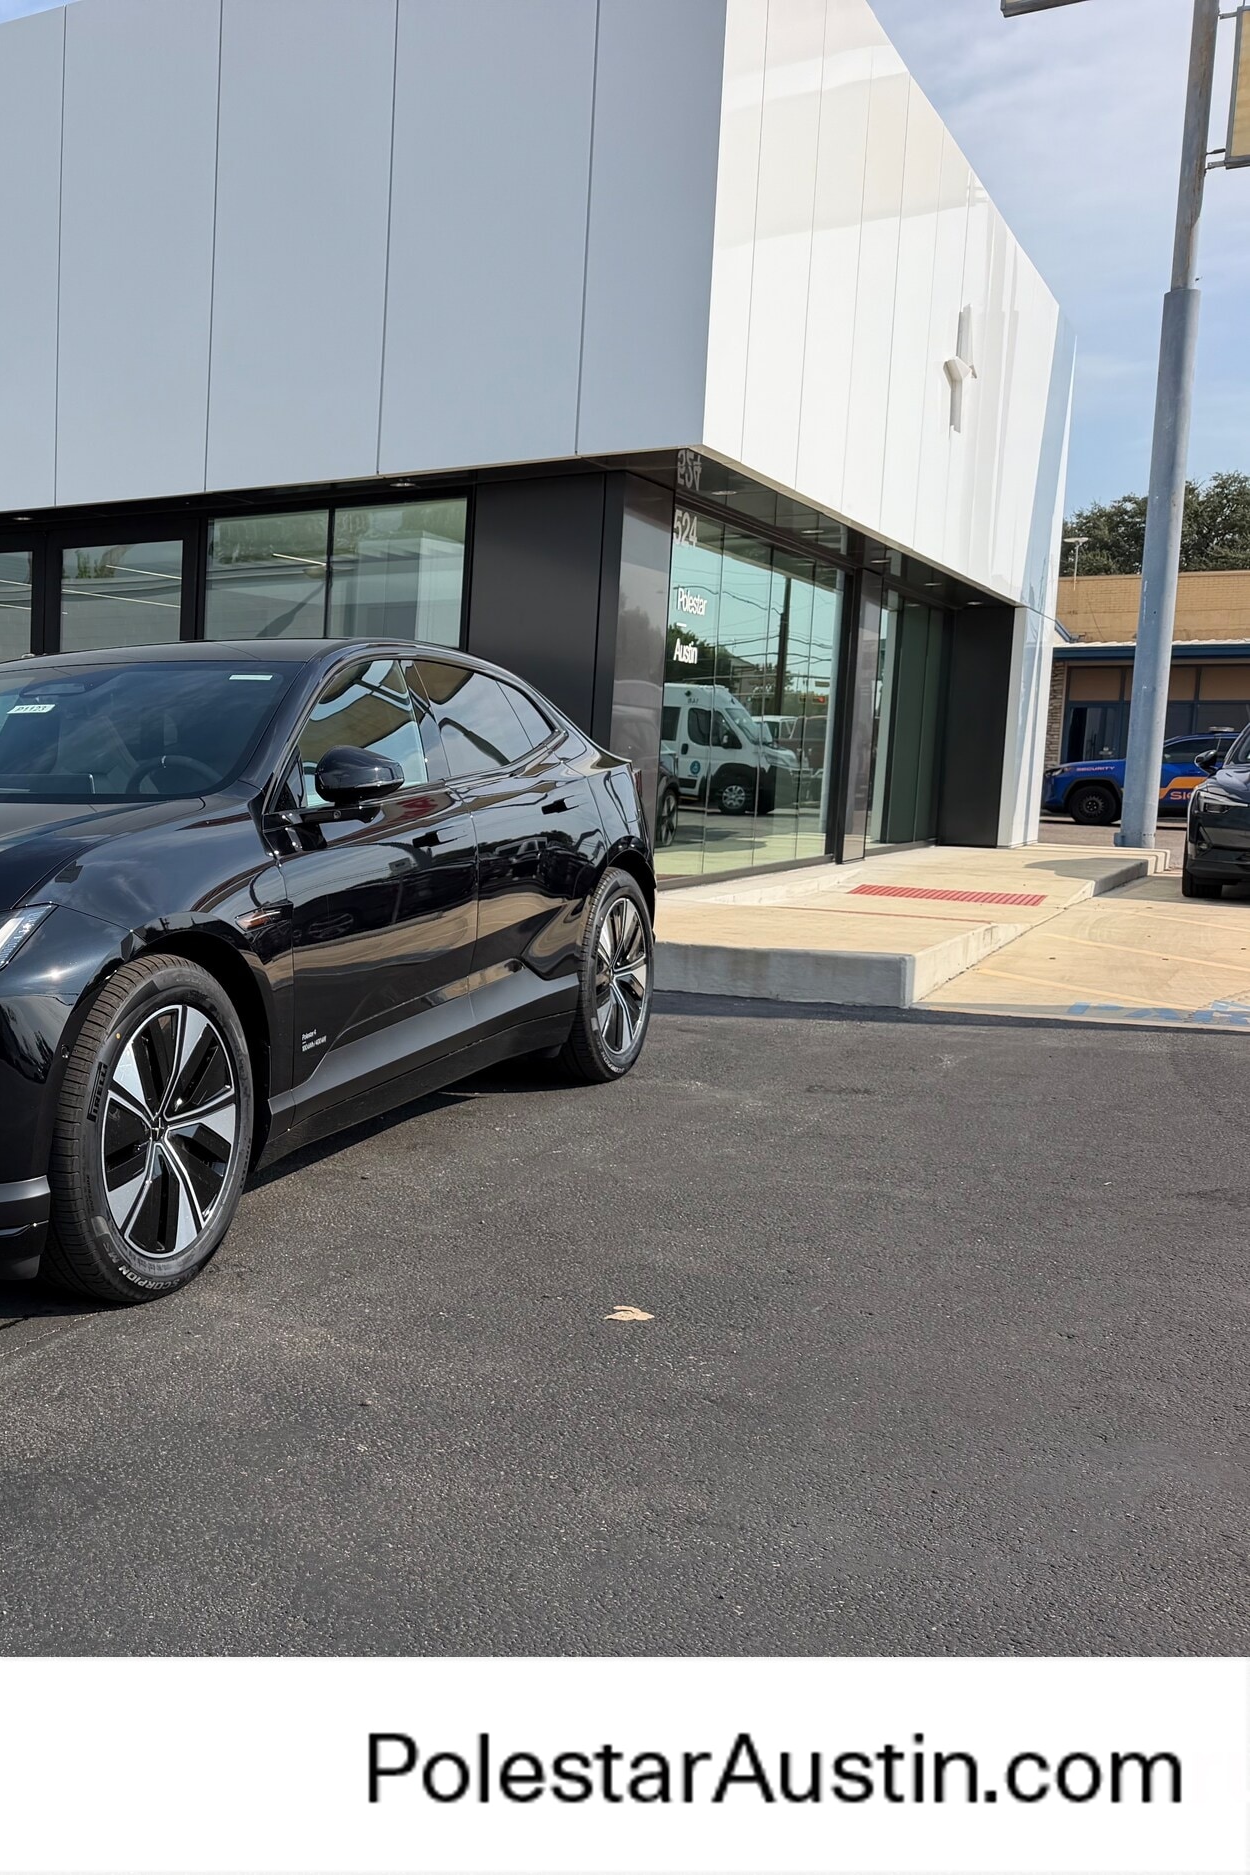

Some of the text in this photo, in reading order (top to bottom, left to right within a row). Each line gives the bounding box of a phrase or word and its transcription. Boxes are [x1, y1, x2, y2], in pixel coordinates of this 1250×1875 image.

[673, 509, 697, 547] 524
[677, 587, 707, 616] Polestar
[673, 638, 698, 664] Austin
[118, 1265, 180, 1290] SCORPION
